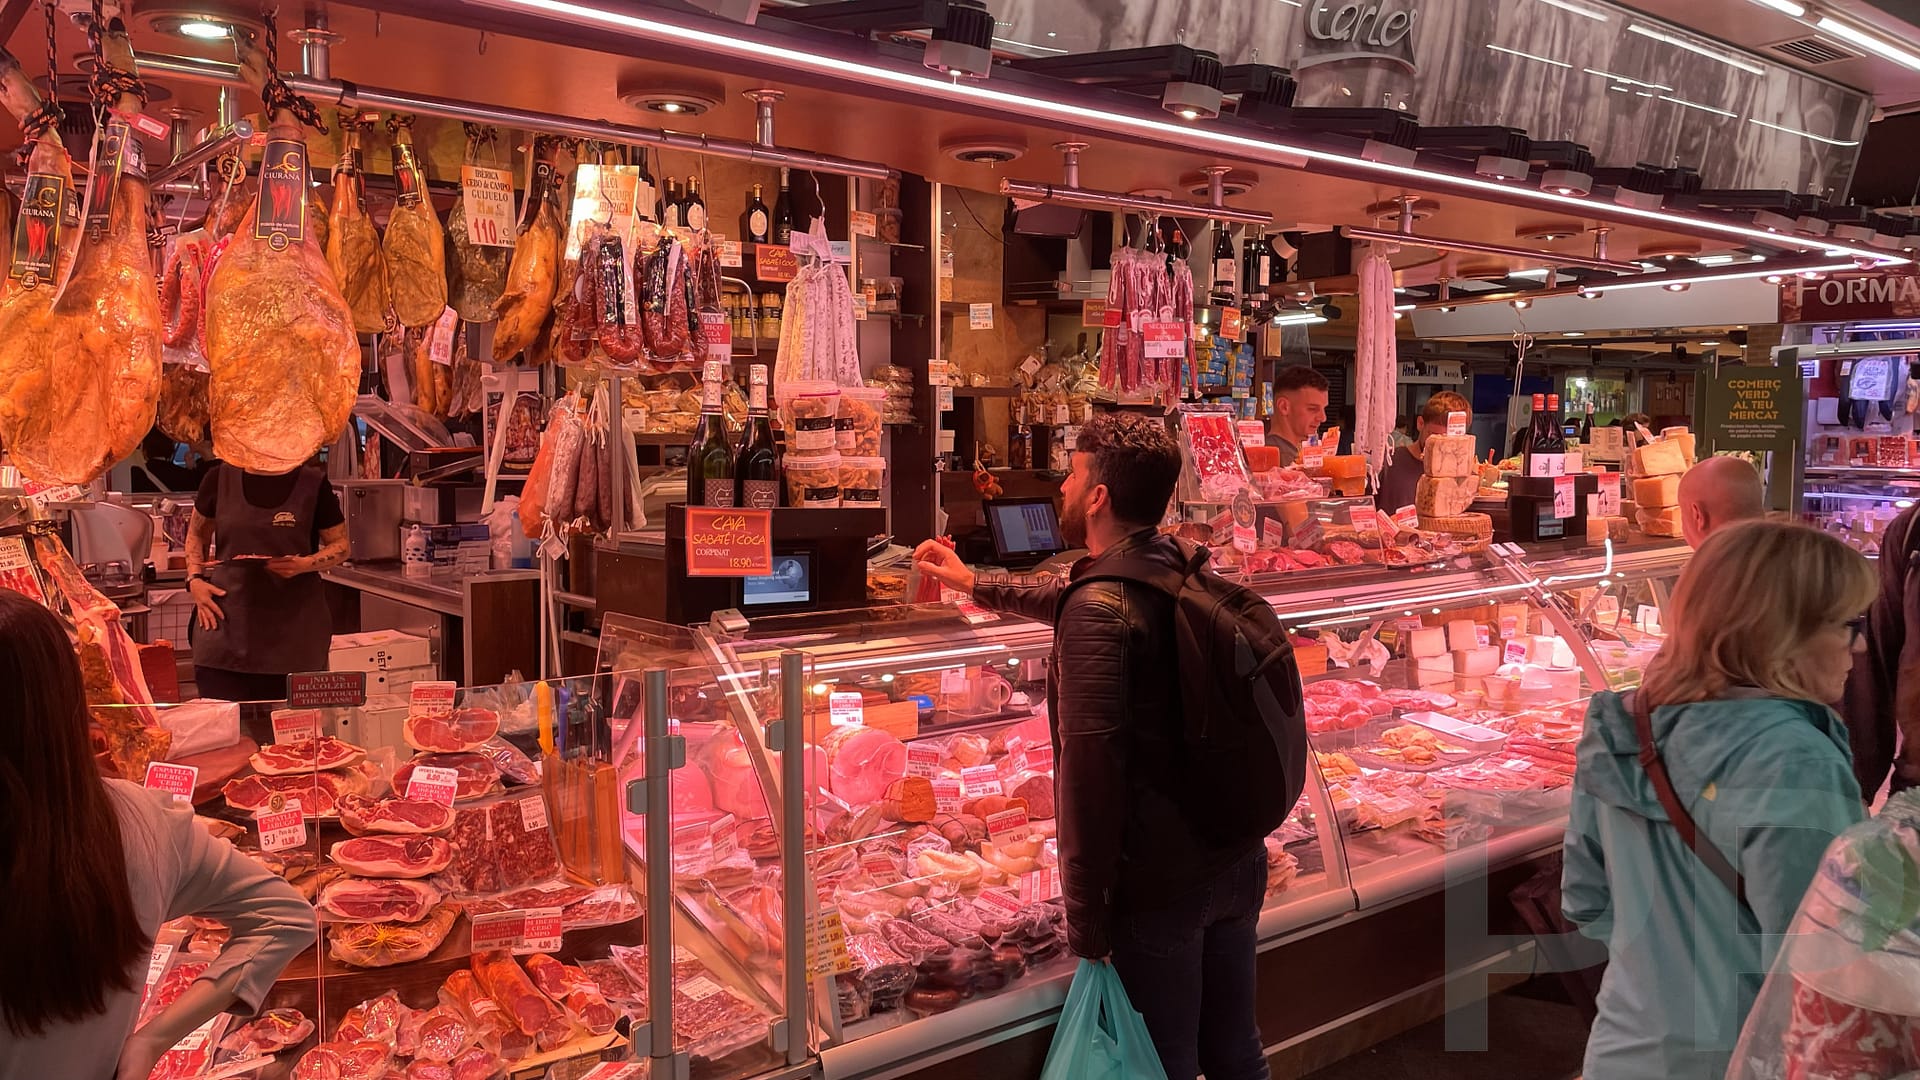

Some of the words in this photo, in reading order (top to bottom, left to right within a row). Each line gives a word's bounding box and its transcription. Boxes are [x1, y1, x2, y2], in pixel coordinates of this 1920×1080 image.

[264, 172, 301, 181] CIURANA
[472, 189, 509, 201] GUIJUELO
[22, 207, 55, 218] CIURANA
[474, 217, 497, 245] 110
[1727, 379, 1782, 392] COMERÇ
[1736, 390, 1771, 400] VERD
[1732, 400, 1749, 410] AL
[1751, 400, 1775, 410] TEU
[1728, 411, 1780, 421] MERCAT
[712, 515, 746, 531] CAVA
[692, 531, 731, 546] SABATÉ
[736, 534, 767, 545] COCA
[729, 556, 752, 568] 18.90
[376, 650, 387, 671] BET
[298, 682, 358, 691] RECOLZEU!
[312, 691, 331, 699] NOT
[331, 690, 361, 698] TOUCH
